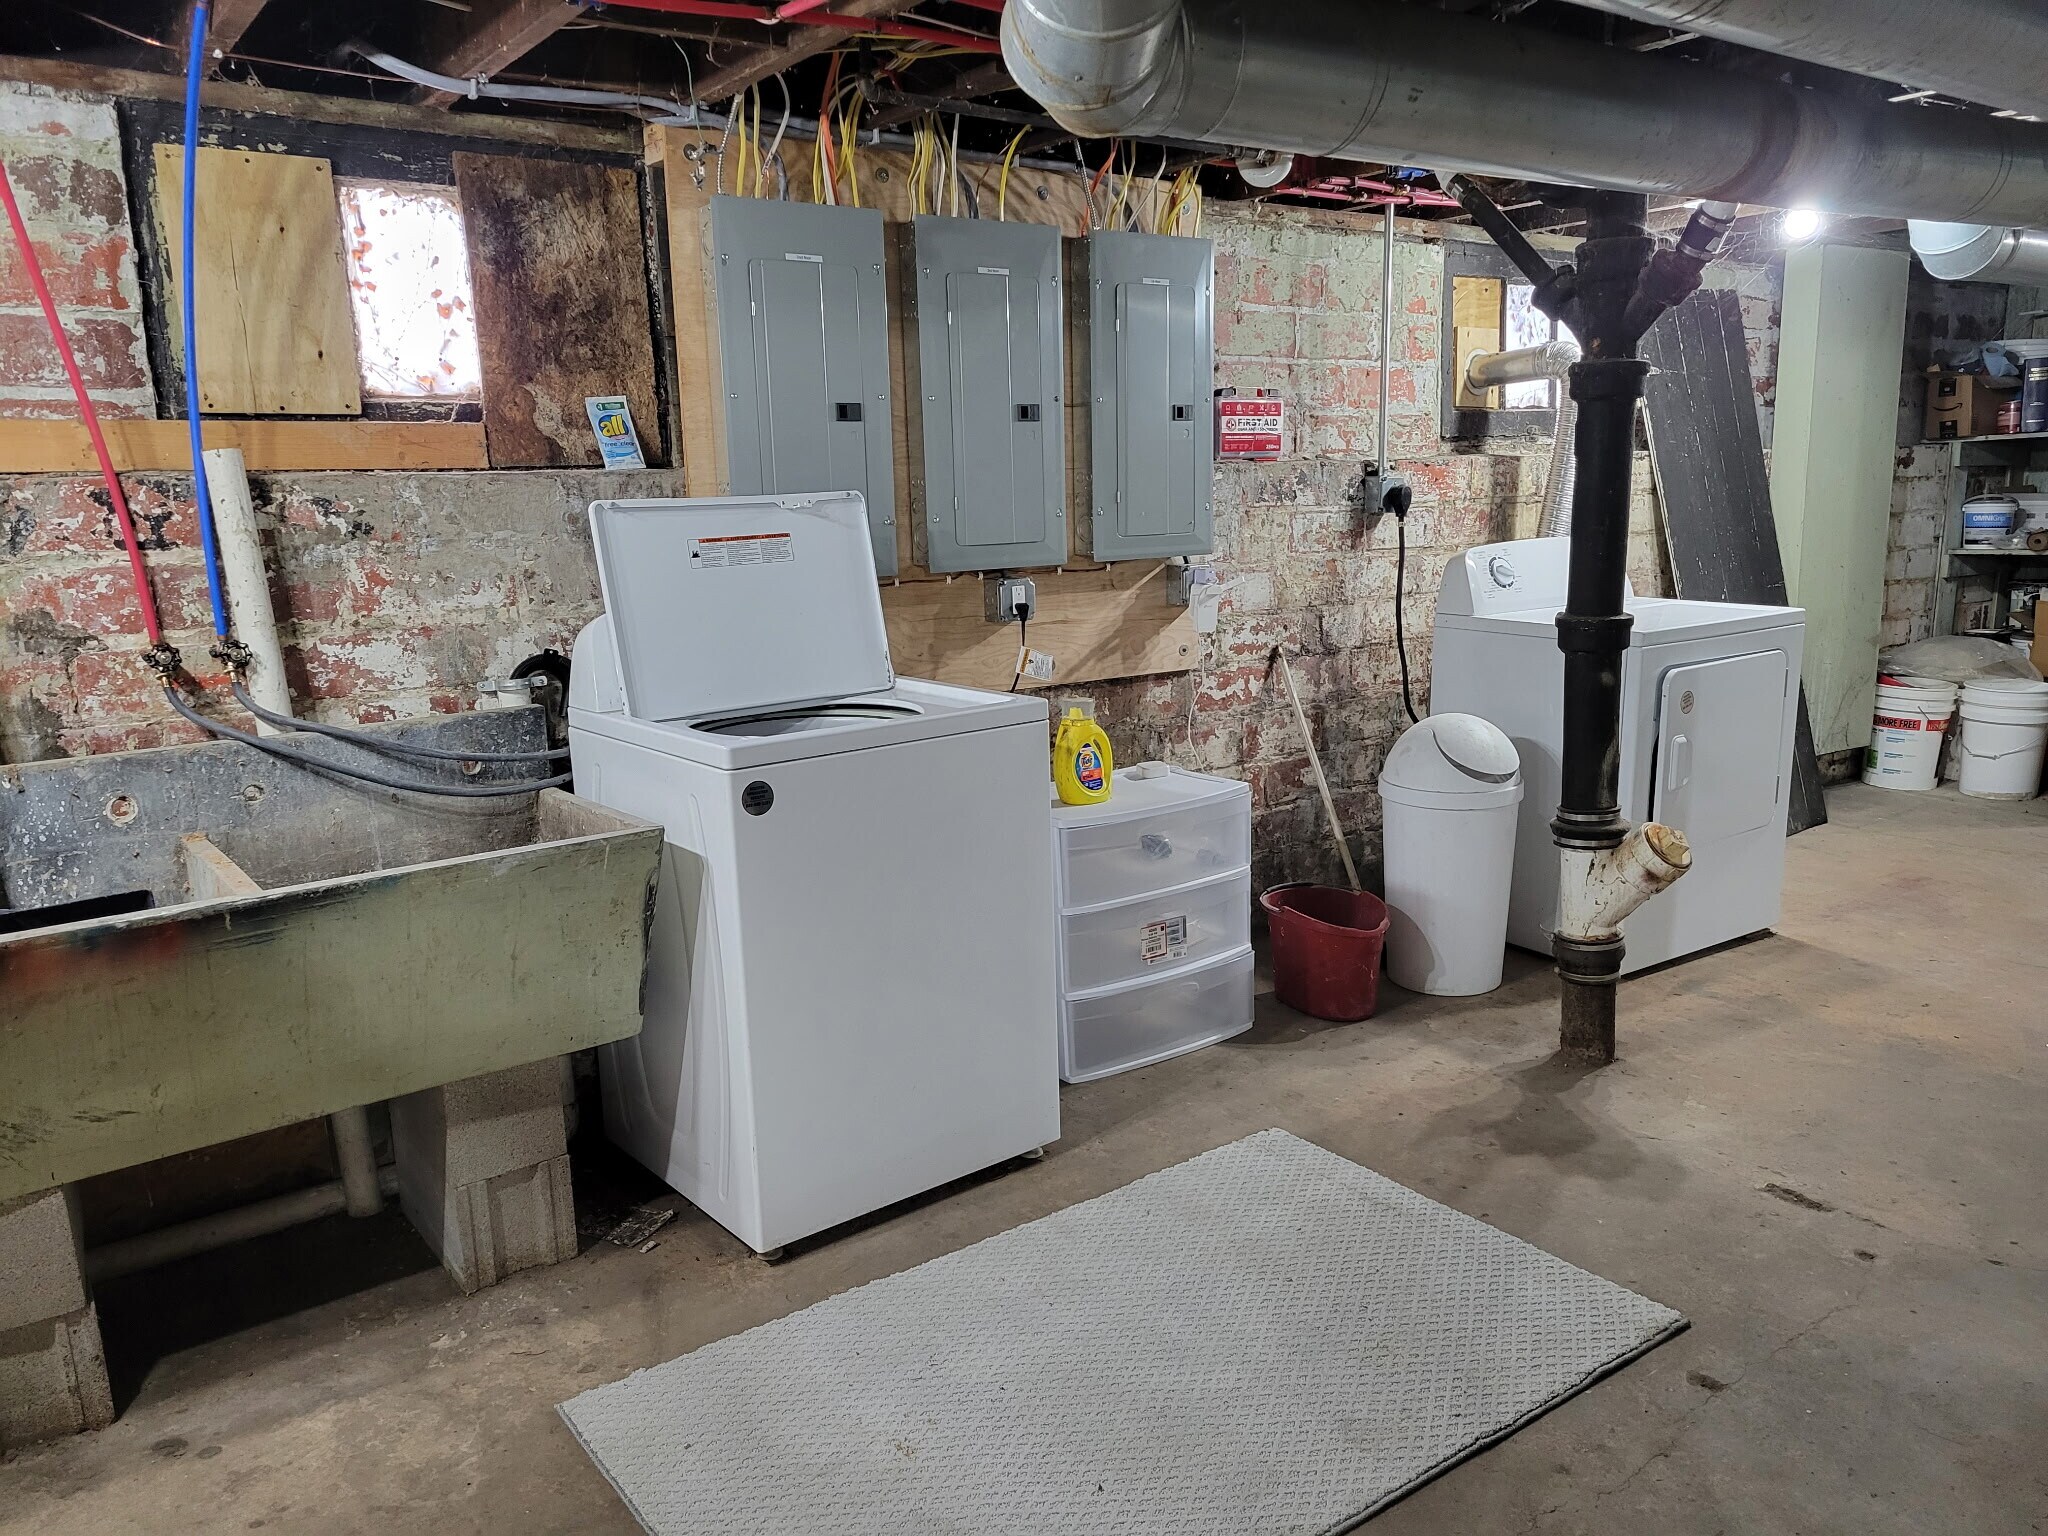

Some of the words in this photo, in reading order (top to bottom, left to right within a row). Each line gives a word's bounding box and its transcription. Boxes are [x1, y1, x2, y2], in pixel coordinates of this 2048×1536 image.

[600, 414, 626, 437] all
[1238, 418, 1262, 427] FIRST
[1263, 418, 1278, 427] AID
[1973, 514, 2006, 523] OMNIGrip
[1879, 717, 1898, 728] MORE
[1899, 719, 1917, 729] FREE
[1080, 756, 1093, 767] Tide
